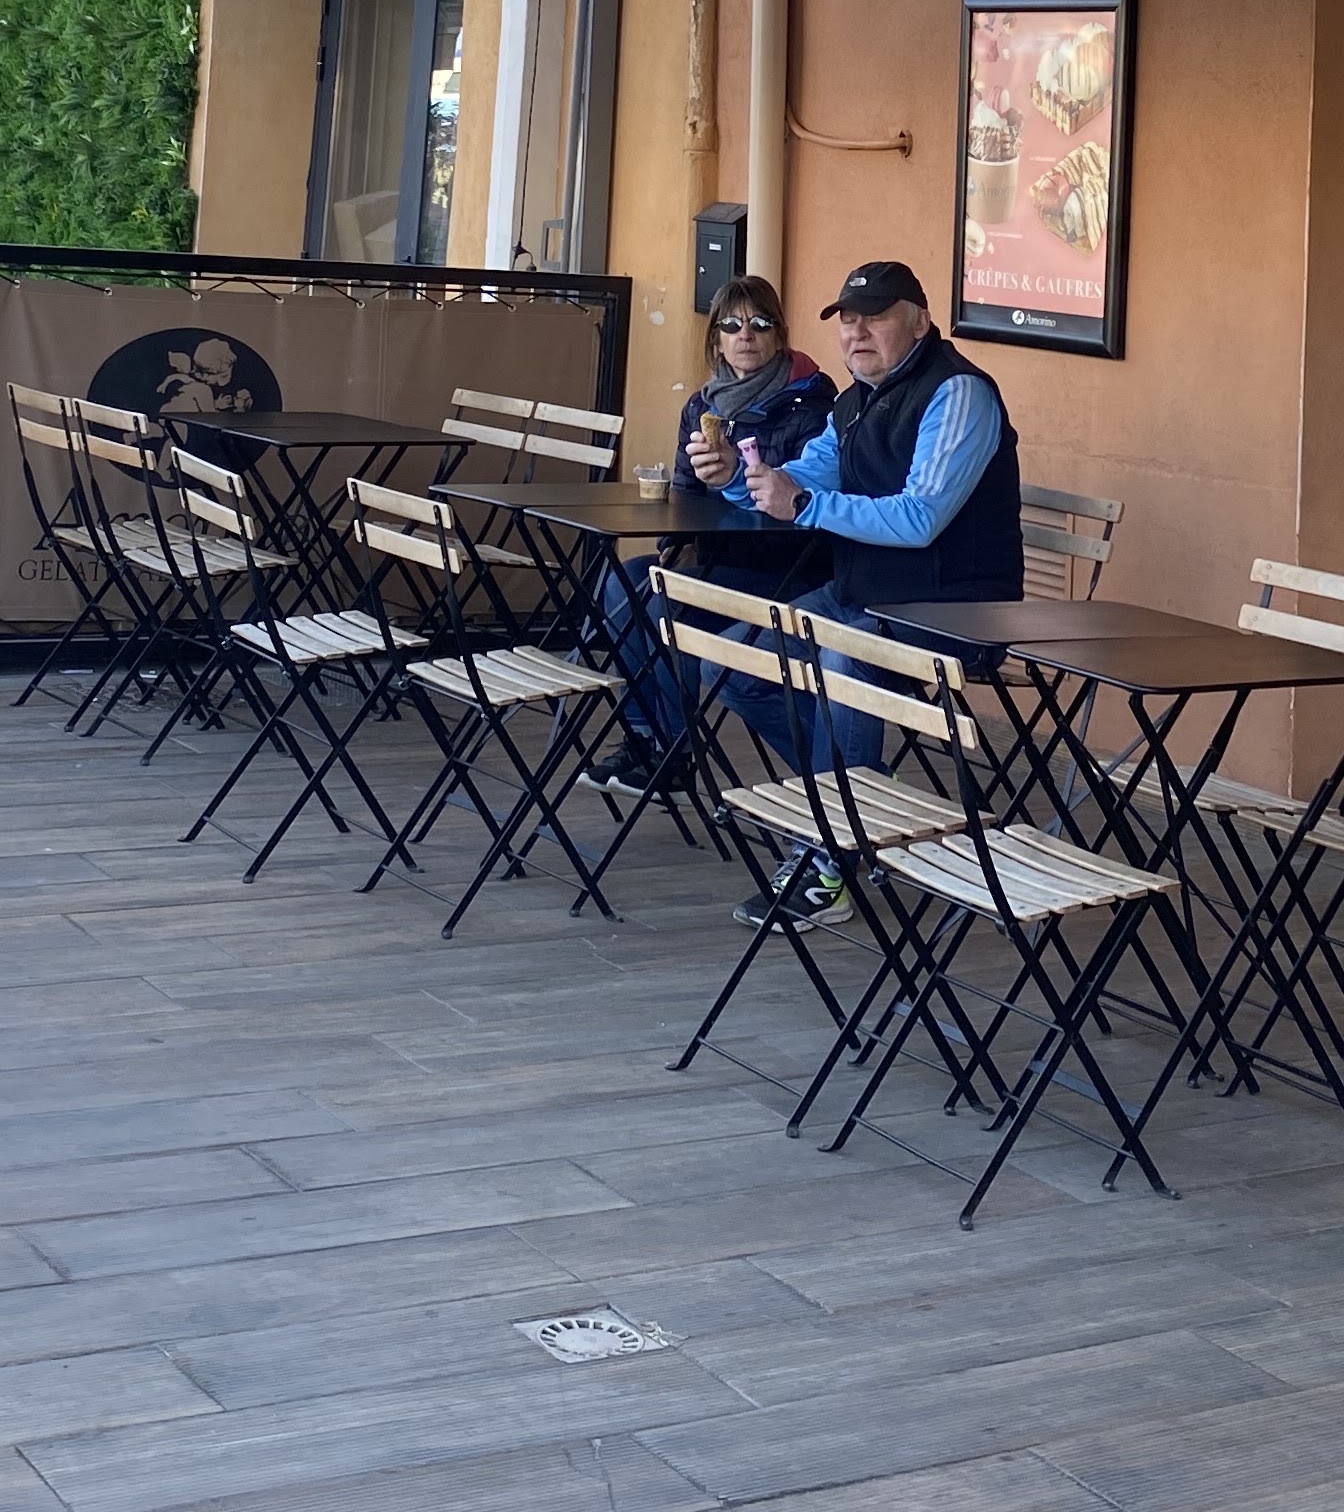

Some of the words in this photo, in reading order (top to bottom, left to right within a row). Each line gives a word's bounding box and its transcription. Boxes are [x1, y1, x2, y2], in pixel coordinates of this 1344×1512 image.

[1021, 274, 1032, 292] &
[1035, 275, 1103, 299] GAUFRES
[1025, 313, 1057, 327] Amorino
